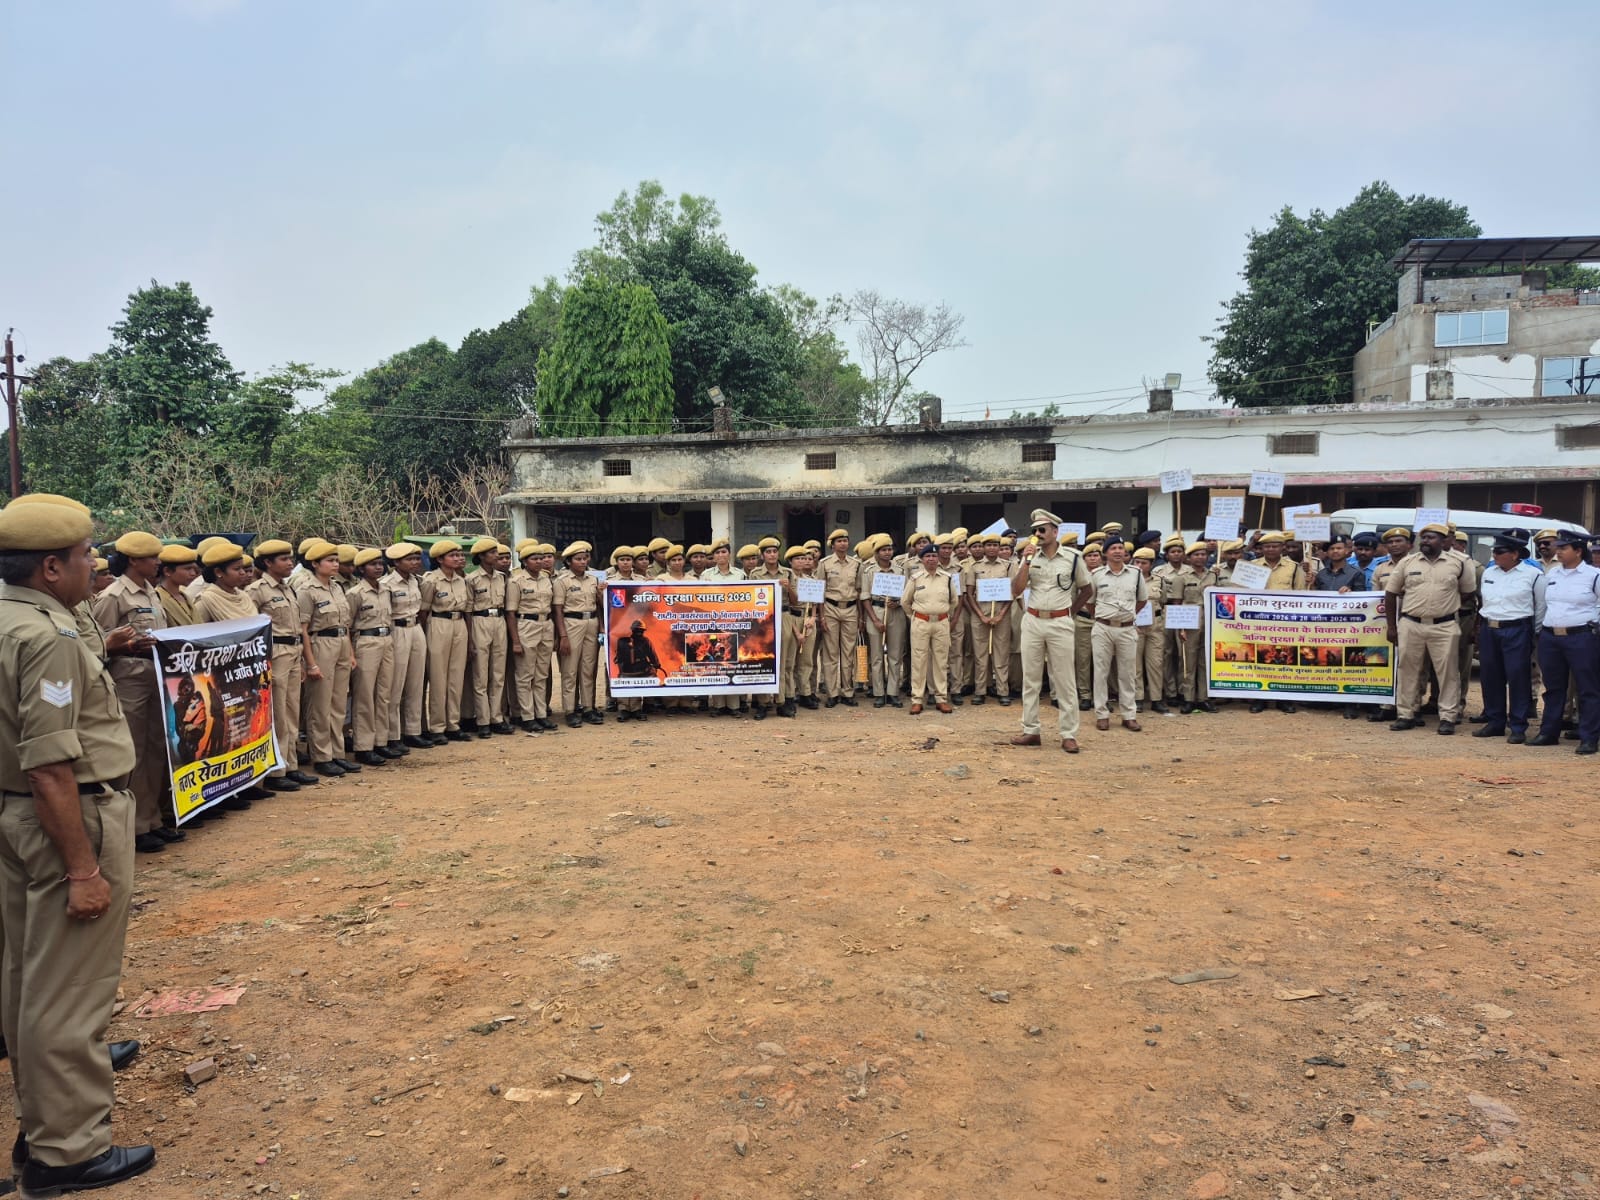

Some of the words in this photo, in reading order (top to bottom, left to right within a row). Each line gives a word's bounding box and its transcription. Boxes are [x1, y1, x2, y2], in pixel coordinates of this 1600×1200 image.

[632, 590, 660, 603] अग्नि
[663, 592, 693, 606] सुरक्षा
[695, 592, 725, 603] सप्ताह
[727, 592, 751, 602] 2026
[1239, 597, 1267, 607] अग्नि
[1271, 600, 1303, 610] सुरक्षा
[1306, 601, 1338, 609] सप्ताह
[1342, 601, 1369, 609] 2026
[1272, 613, 1289, 621] 2026
[1302, 624, 1311, 634] के
[1350, 625, 1359, 634] के
[1269, 635, 1295, 644] सुरक्षा
[165, 642, 200, 677] अग्नि
[201, 644, 238, 678] सुरक्षा
[224, 669, 235, 683] 14
[178, 771, 197, 792] नगर
[197, 761, 228, 782] सेना
[231, 740, 270, 770] जगदलपुर
